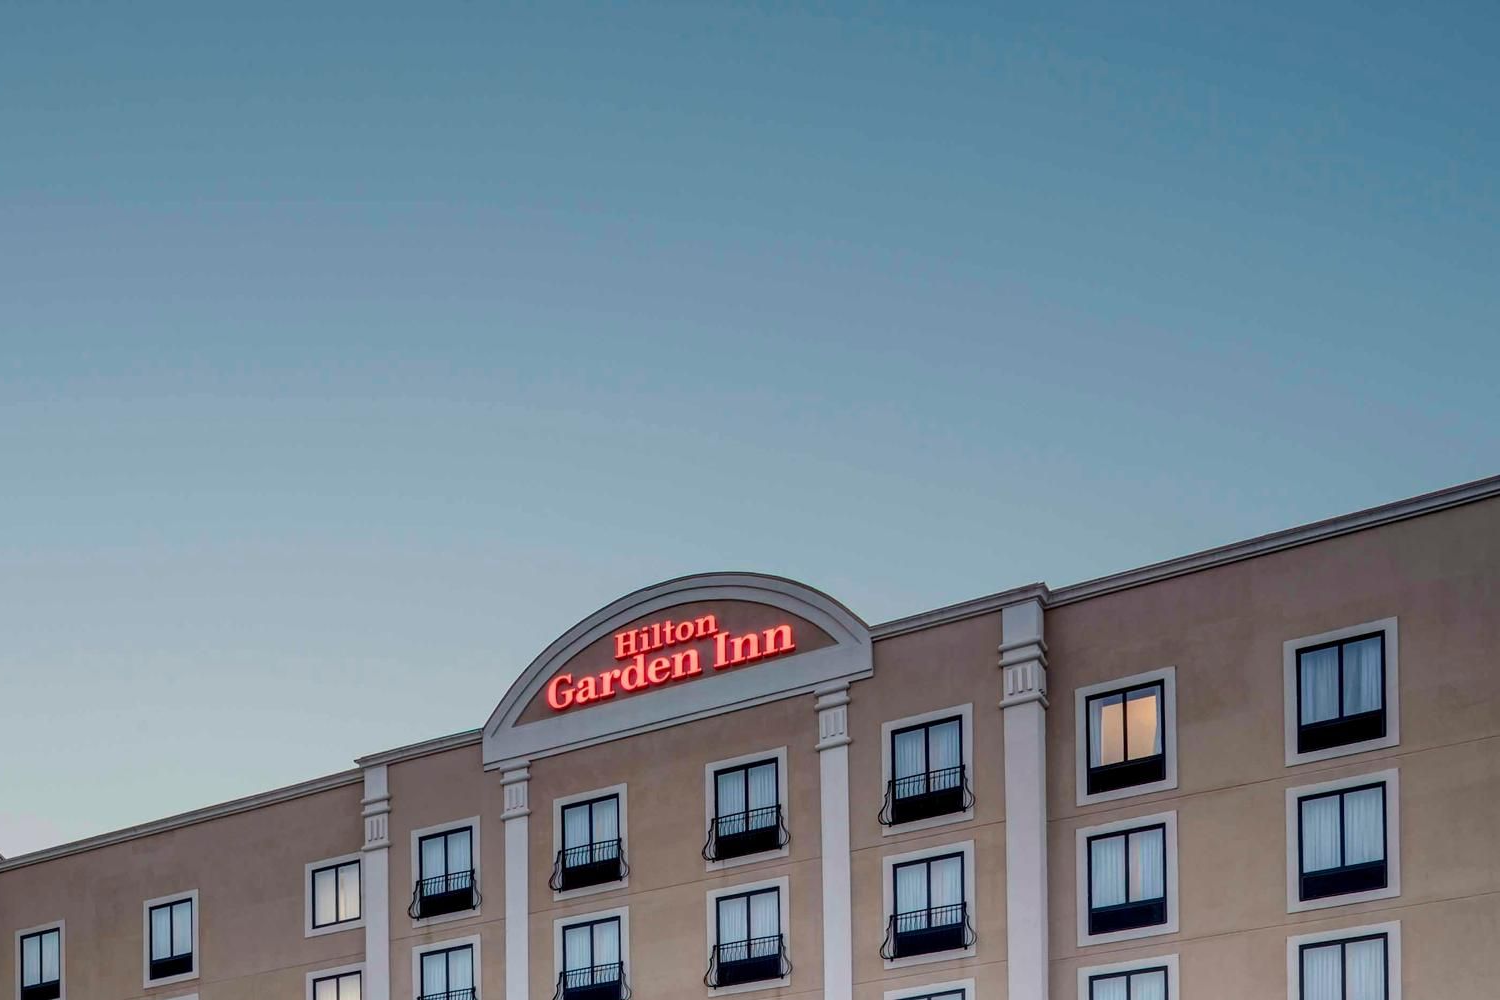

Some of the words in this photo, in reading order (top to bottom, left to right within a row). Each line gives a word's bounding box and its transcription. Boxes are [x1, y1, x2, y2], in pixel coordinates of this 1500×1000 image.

[548, 649, 702, 711] Garden
[713, 624, 796, 670] Inn
[615, 614, 718, 660] Hilton
